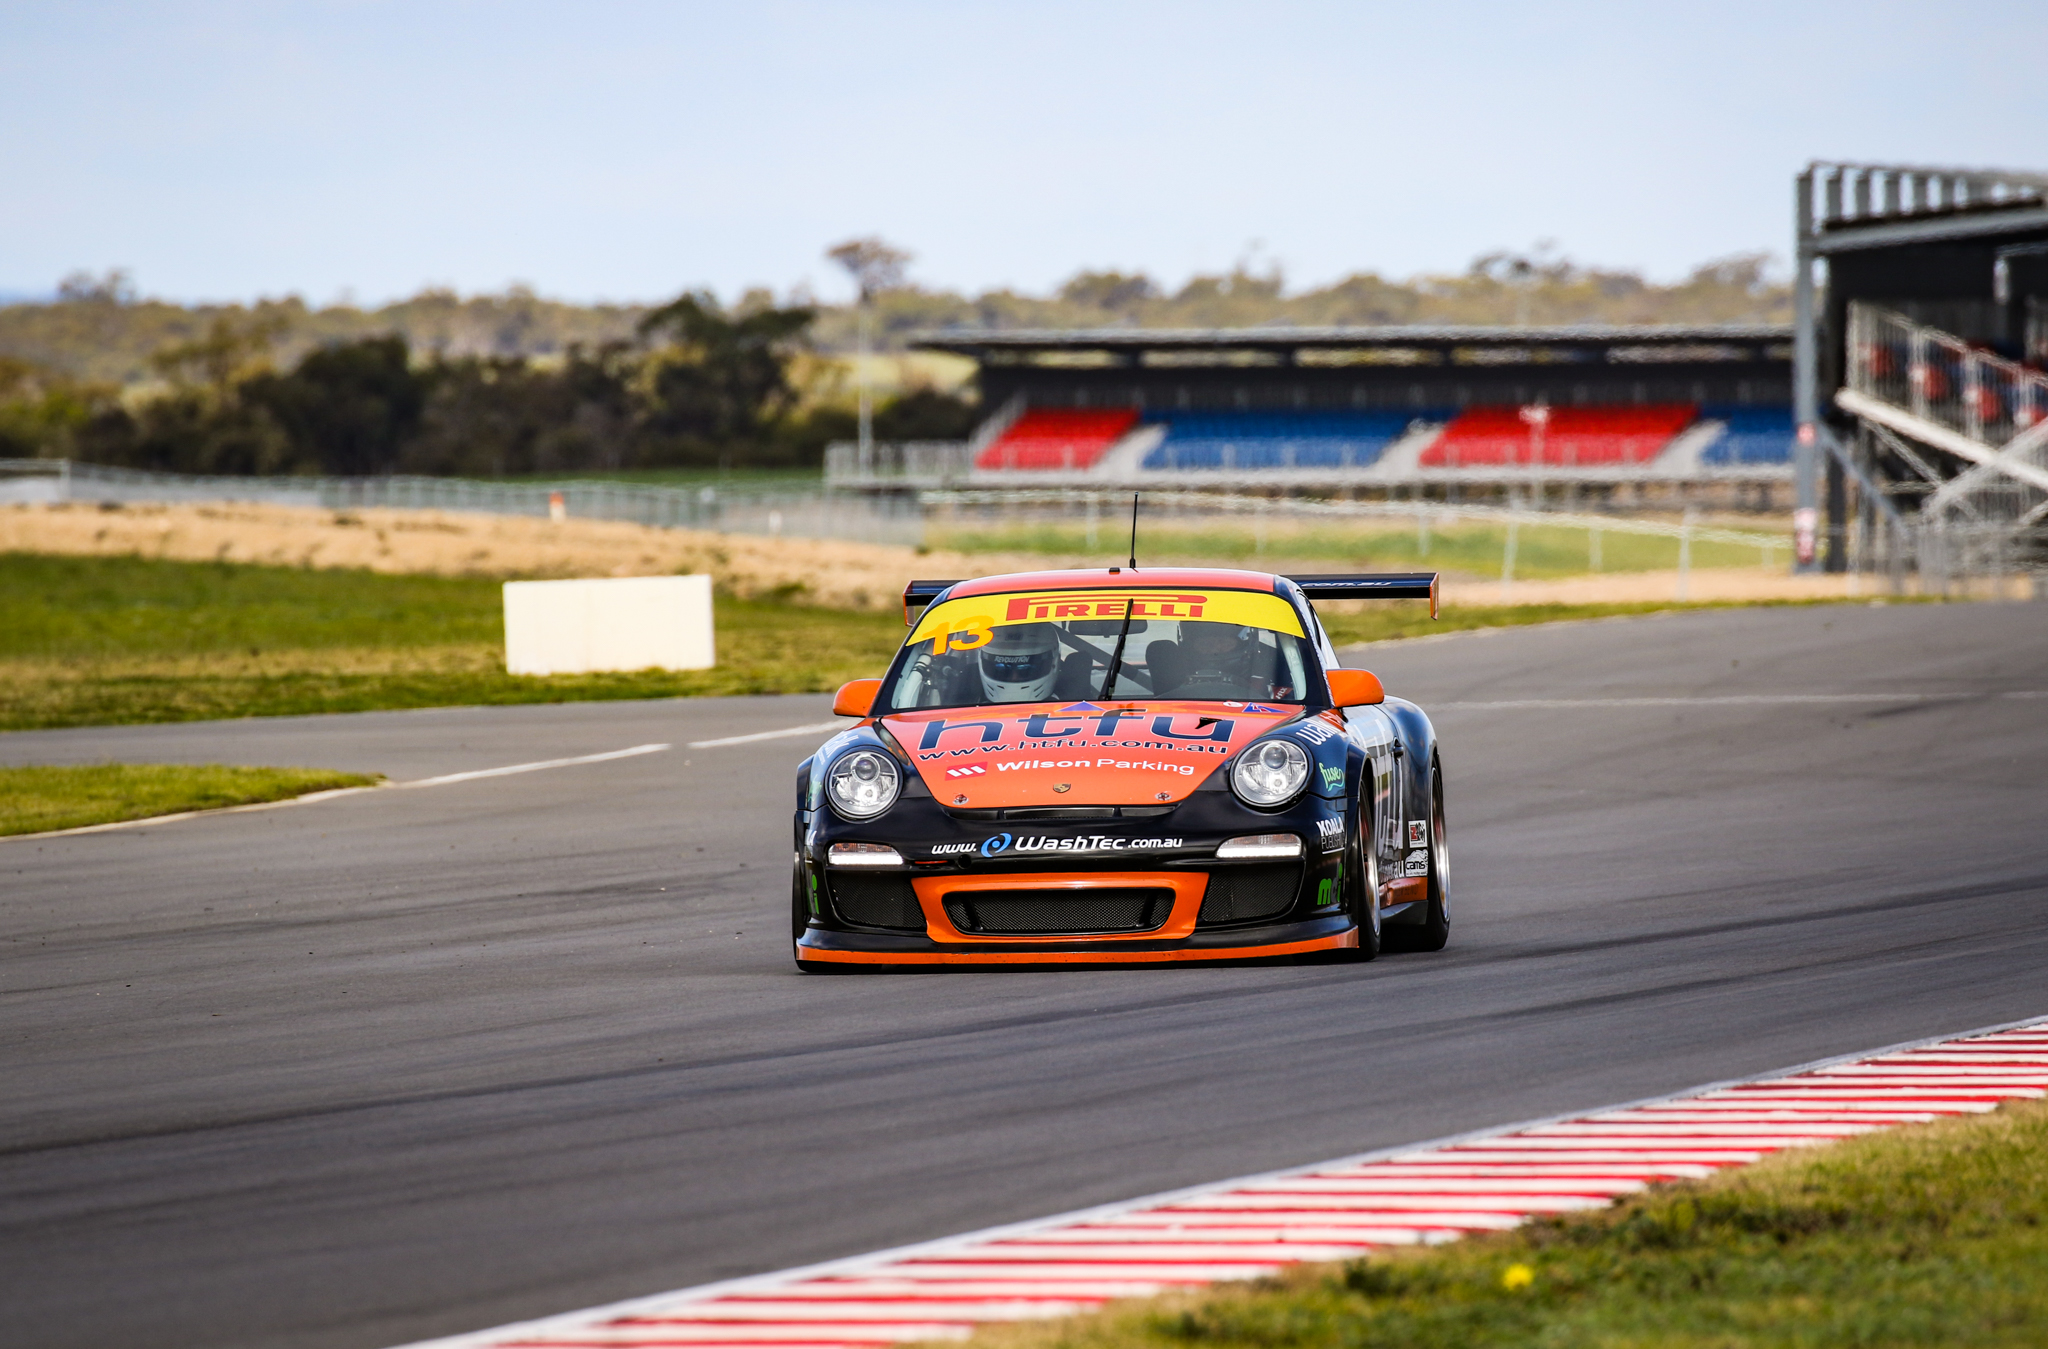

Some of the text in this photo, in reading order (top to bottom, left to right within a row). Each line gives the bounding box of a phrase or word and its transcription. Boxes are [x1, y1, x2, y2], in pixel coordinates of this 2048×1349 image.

[1006, 594, 1208, 622] PIRELLI
[922, 615, 995, 656] 13
[994, 655, 1031, 664] REVOLUTION
[917, 708, 1236, 751] htfu
[918, 739, 1229, 762] www.htfu.com.au
[997, 758, 1195, 776] Wilson Parking
[1316, 816, 1345, 837] KOALA
[931, 843, 977, 855] www.
[1127, 837, 1183, 849] .com.au
[1321, 834, 1345, 850] PUBLISH
